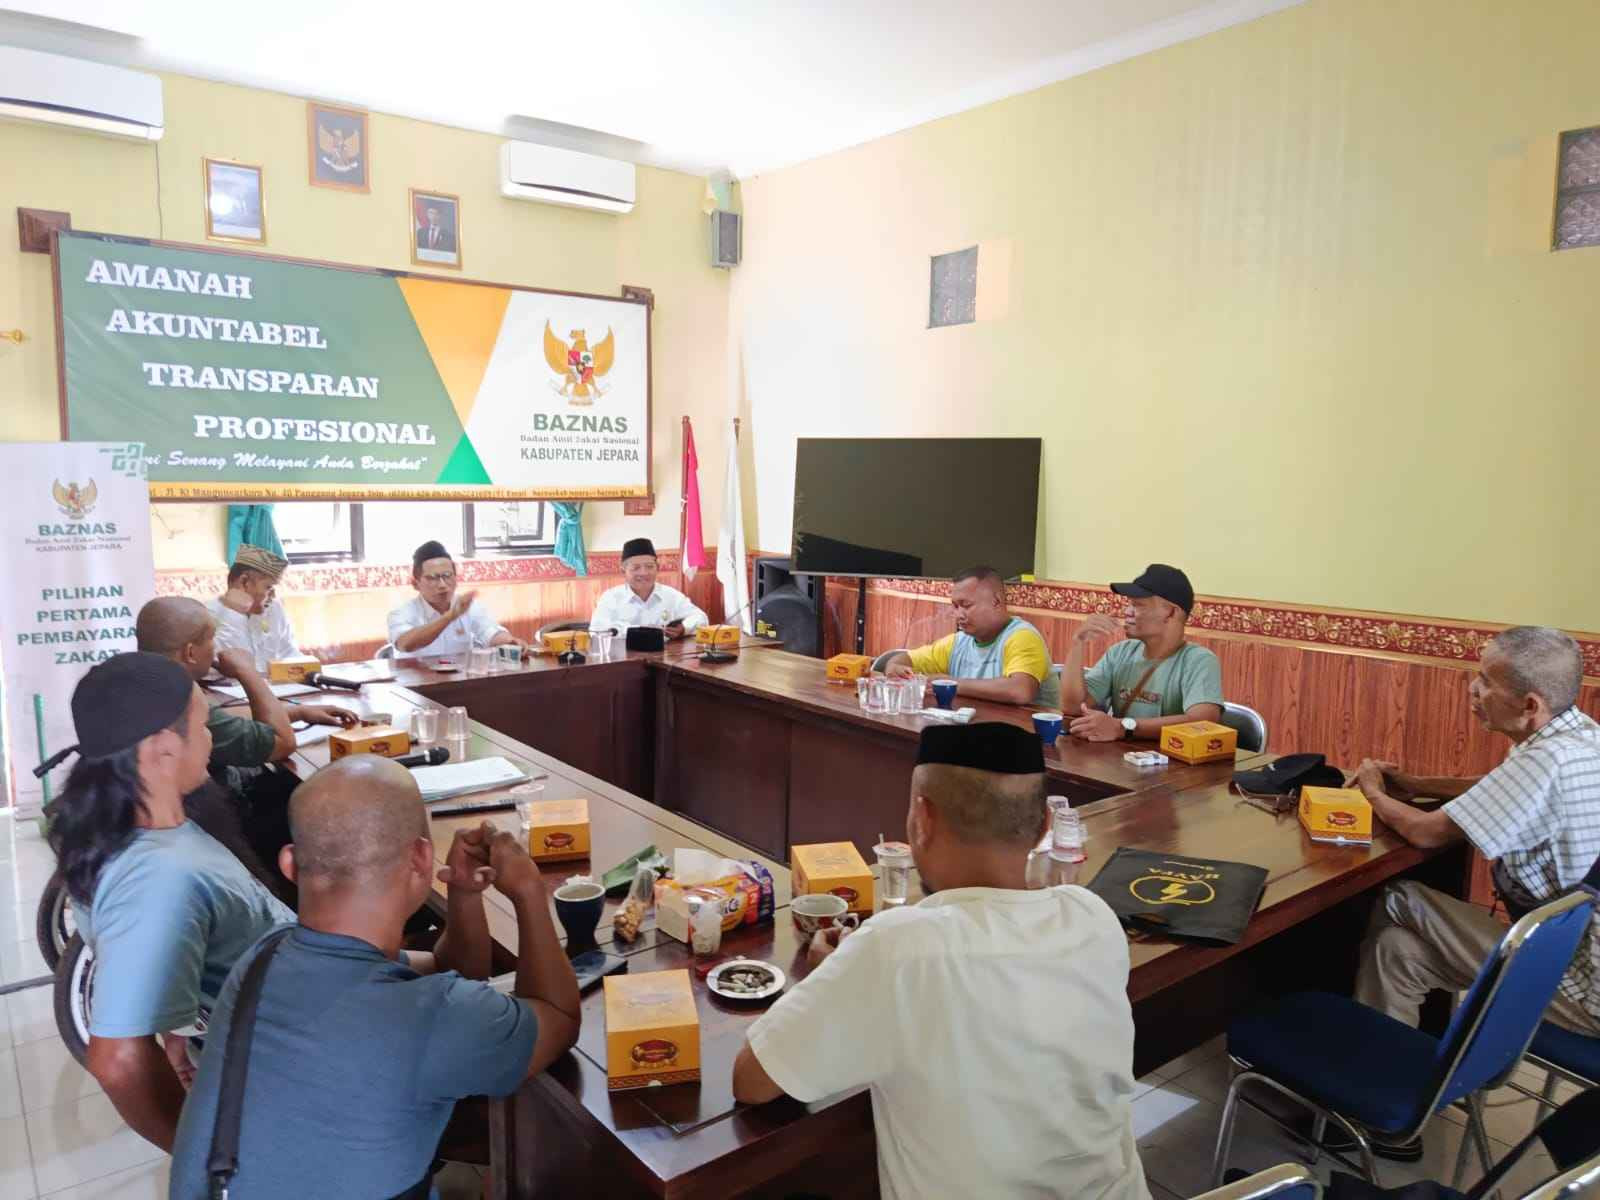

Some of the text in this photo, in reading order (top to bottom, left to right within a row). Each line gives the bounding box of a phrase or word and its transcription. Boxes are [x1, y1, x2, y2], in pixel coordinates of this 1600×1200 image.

[85, 259, 253, 300] AMANAH
[106, 309, 328, 349] AKUNTABEL
[143, 362, 379, 399] TRANSPARAN
[193, 414, 436, 446] PROFESIONAL
[533, 413, 628, 433] BAZNAS
[520, 434, 549, 443] Badan
[602, 437, 640, 446] Nasional
[167, 450, 227, 471] Senang
[233, 451, 309, 471] Melayani
[312, 455, 354, 470] Anda
[520, 447, 639, 462] KABUPATEN JEPARA
[38, 522, 117, 536] BAZNAS
[35, 543, 122, 552] KABUPATEN JEPARA
[42, 584, 124, 600] PILIHAN
[37, 605, 133, 623] PERTAMA
[17, 627, 138, 646] PEMBAYARA
